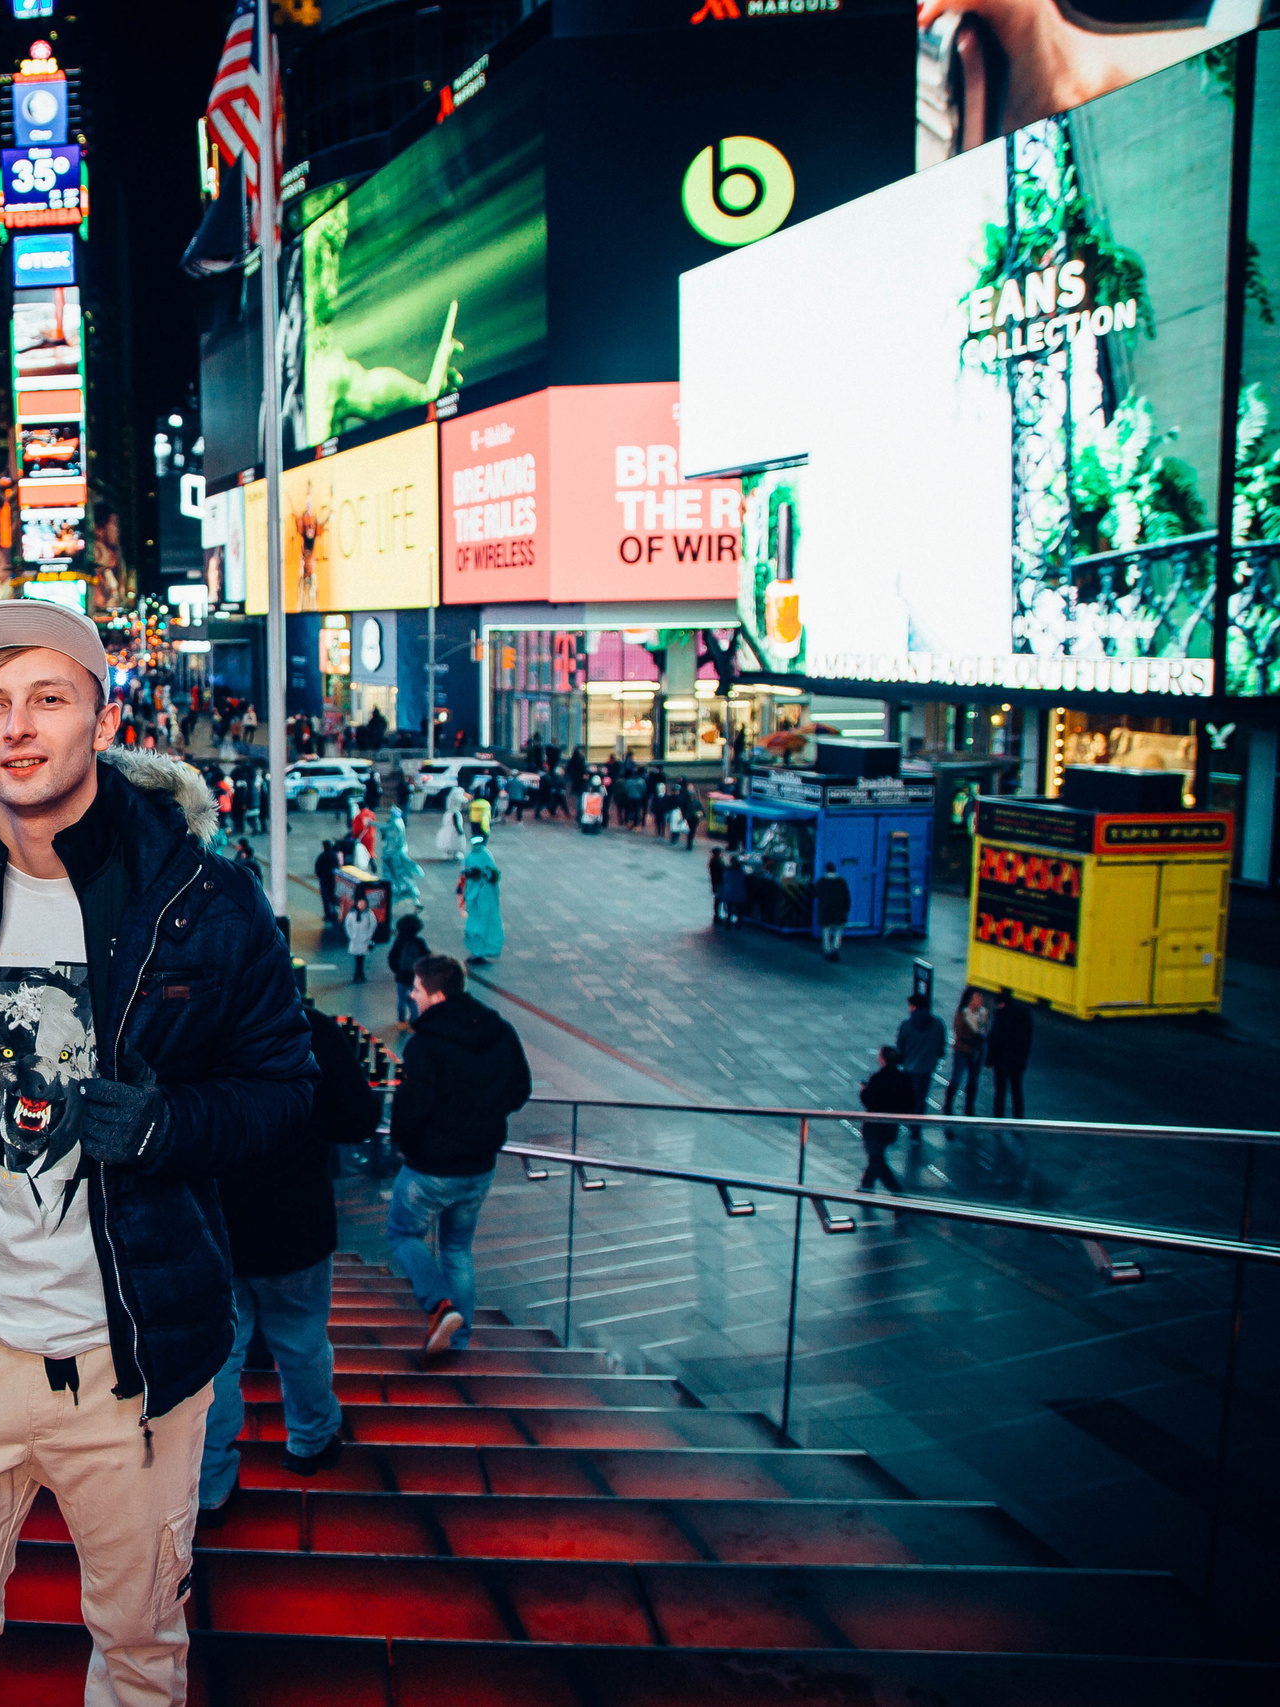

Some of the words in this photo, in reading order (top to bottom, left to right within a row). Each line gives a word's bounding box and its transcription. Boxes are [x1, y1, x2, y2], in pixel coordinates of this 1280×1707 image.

[747, 0, 840, 16] MARQUIS
[5, 206, 82, 229] TOSHIBA
[962, 298, 1137, 366] COLLECTION
[453, 453, 536, 506] BREAKING
[615, 444, 686, 487] BR
[453, 505, 485, 543] THE
[484, 496, 537, 539] RULES
[615, 489, 703, 531] THE
[457, 547, 471, 572] OF
[474, 539, 536, 570] WIRELESS
[619, 535, 664, 564] OF
[673, 534, 737, 563] WIR
[137, 1122, 156, 1156] HEAD
